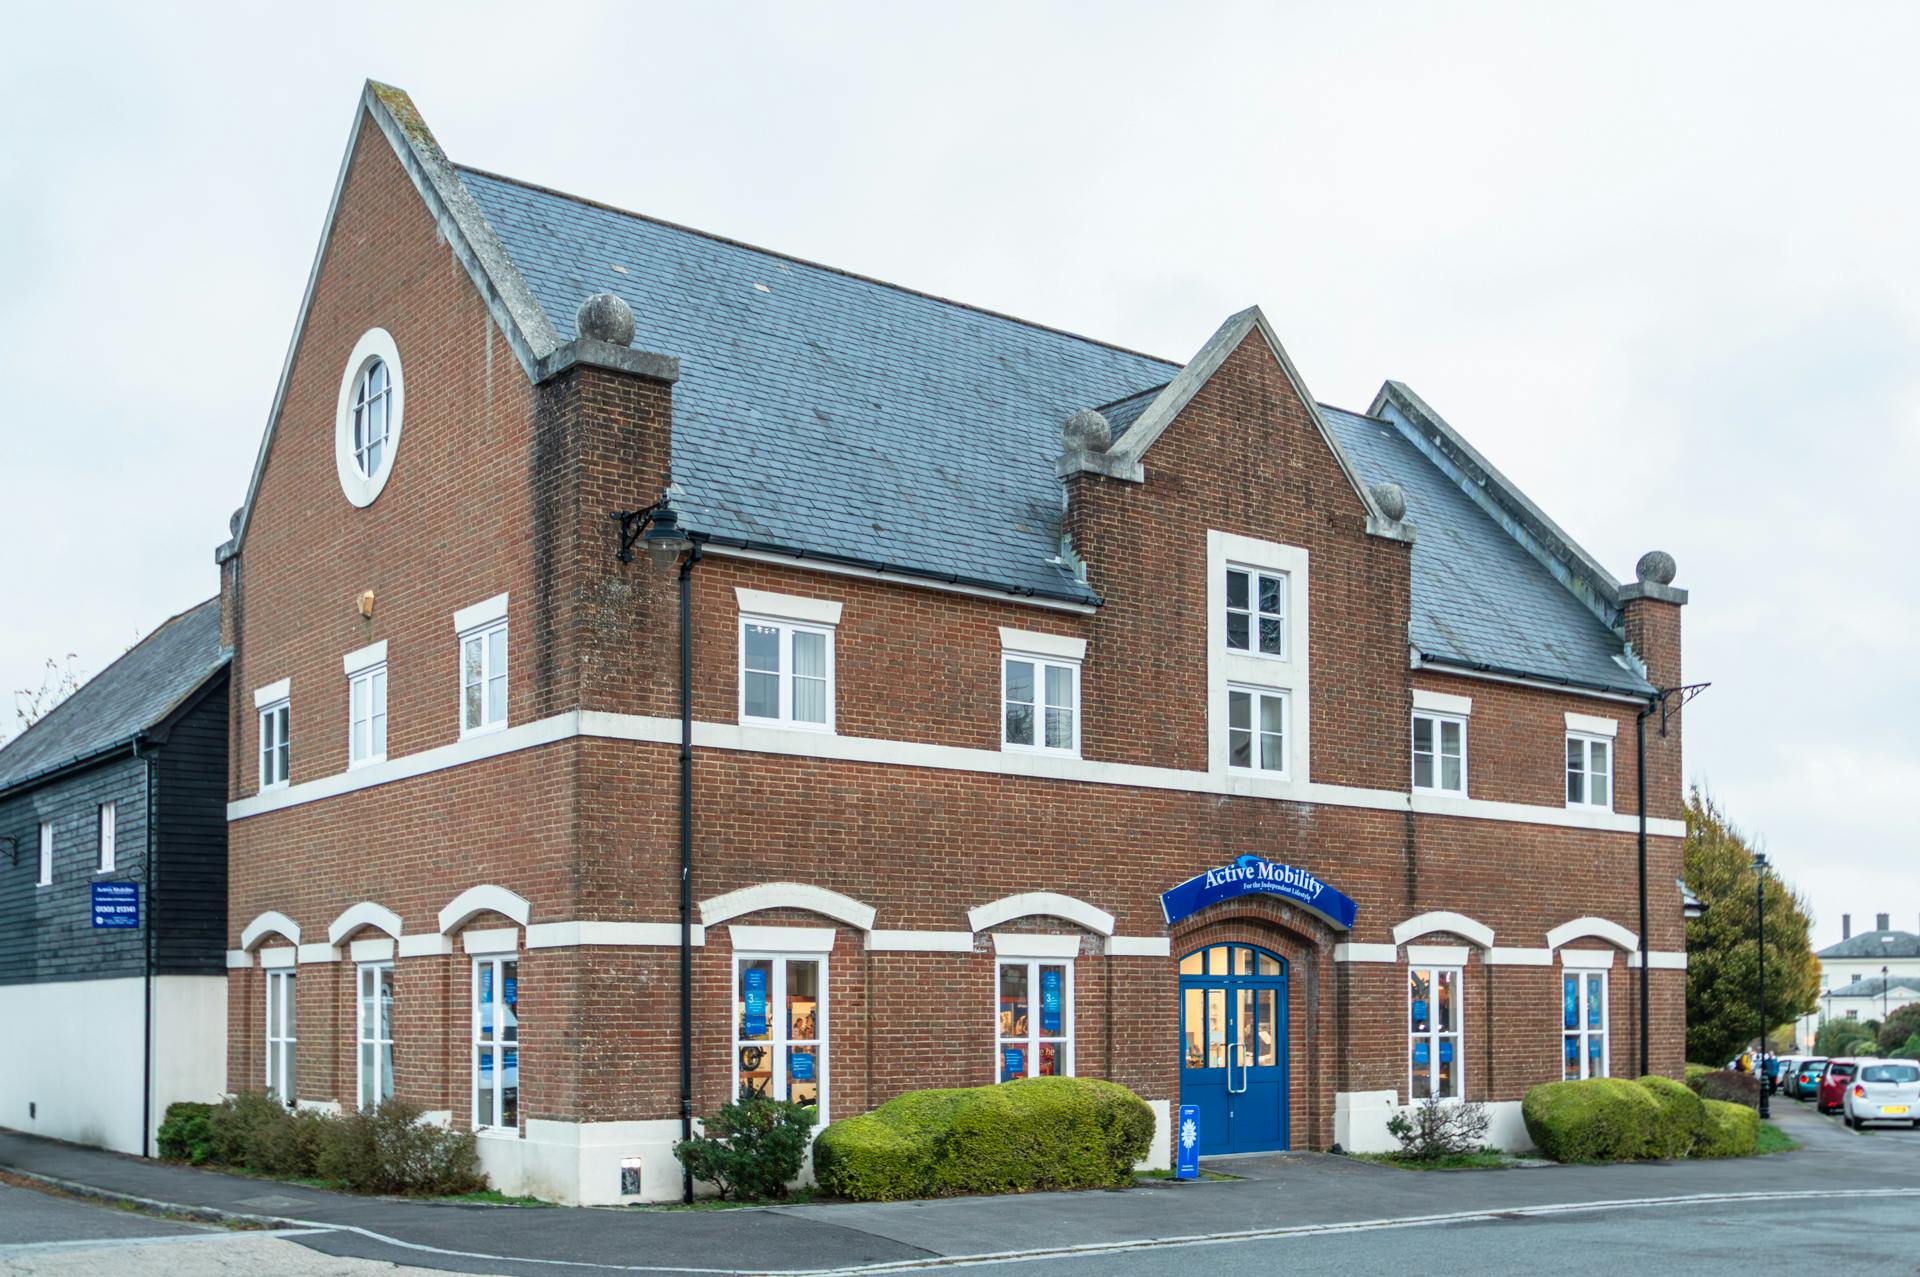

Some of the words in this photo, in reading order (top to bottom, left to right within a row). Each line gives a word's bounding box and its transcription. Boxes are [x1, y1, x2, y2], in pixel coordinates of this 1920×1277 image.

[1204, 864, 1255, 890] Active
[1257, 862, 1324, 899] Mobility
[1261, 881, 1291, 893] Independent
[1291, 887, 1311, 900] Lifestyle
[748, 993, 754, 1003] 3
